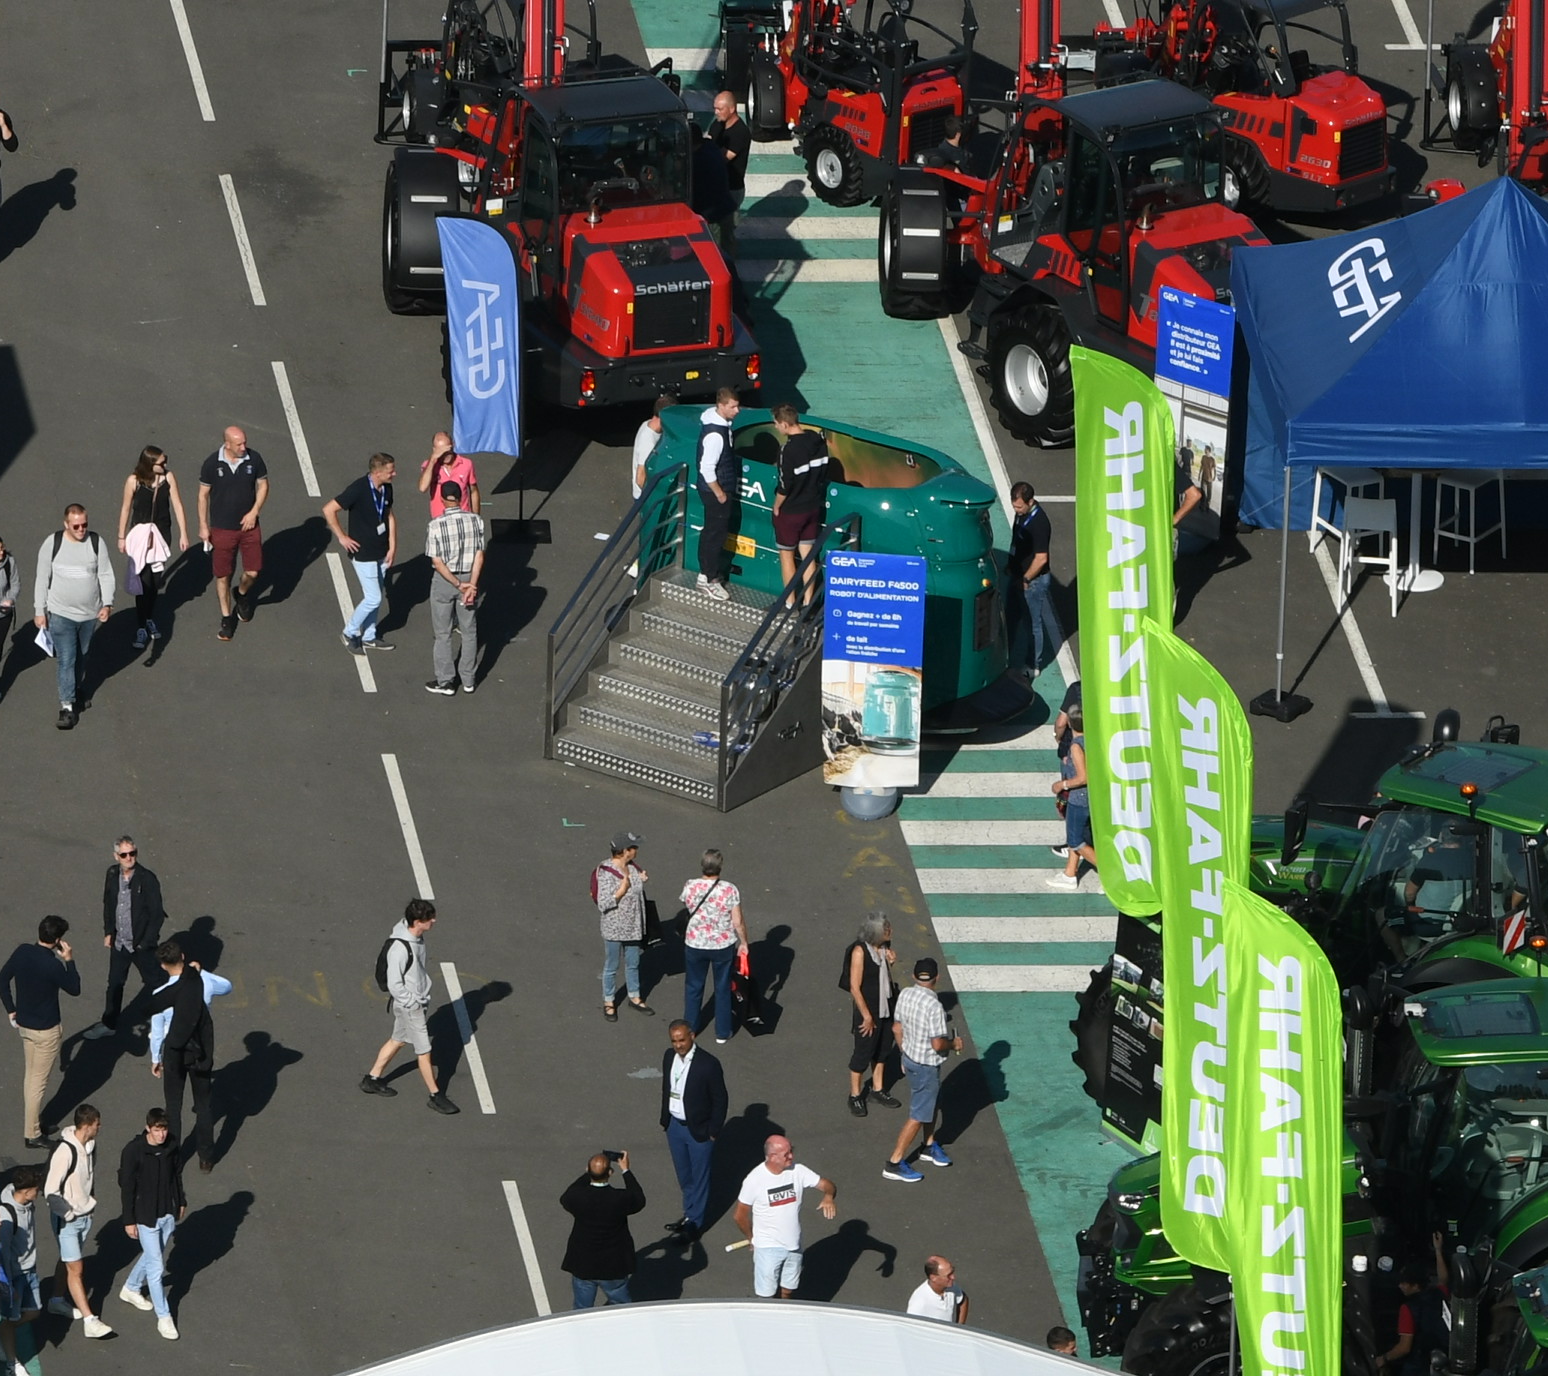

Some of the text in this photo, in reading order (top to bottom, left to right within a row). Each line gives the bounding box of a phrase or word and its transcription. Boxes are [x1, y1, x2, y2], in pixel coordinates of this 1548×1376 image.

[633, 279, 714, 297] Schäffer
[1328, 237, 1402, 344] GEA
[1162, 291, 1179, 305] GEA
[1171, 330, 1205, 345] distributeur
[831, 556, 858, 568] GEA
[829, 576, 920, 591] DAIRYFEED F4500
[829, 590, 920, 603] ROBOT D'ALIMENTATION
[846, 610, 874, 621] Gagnez
